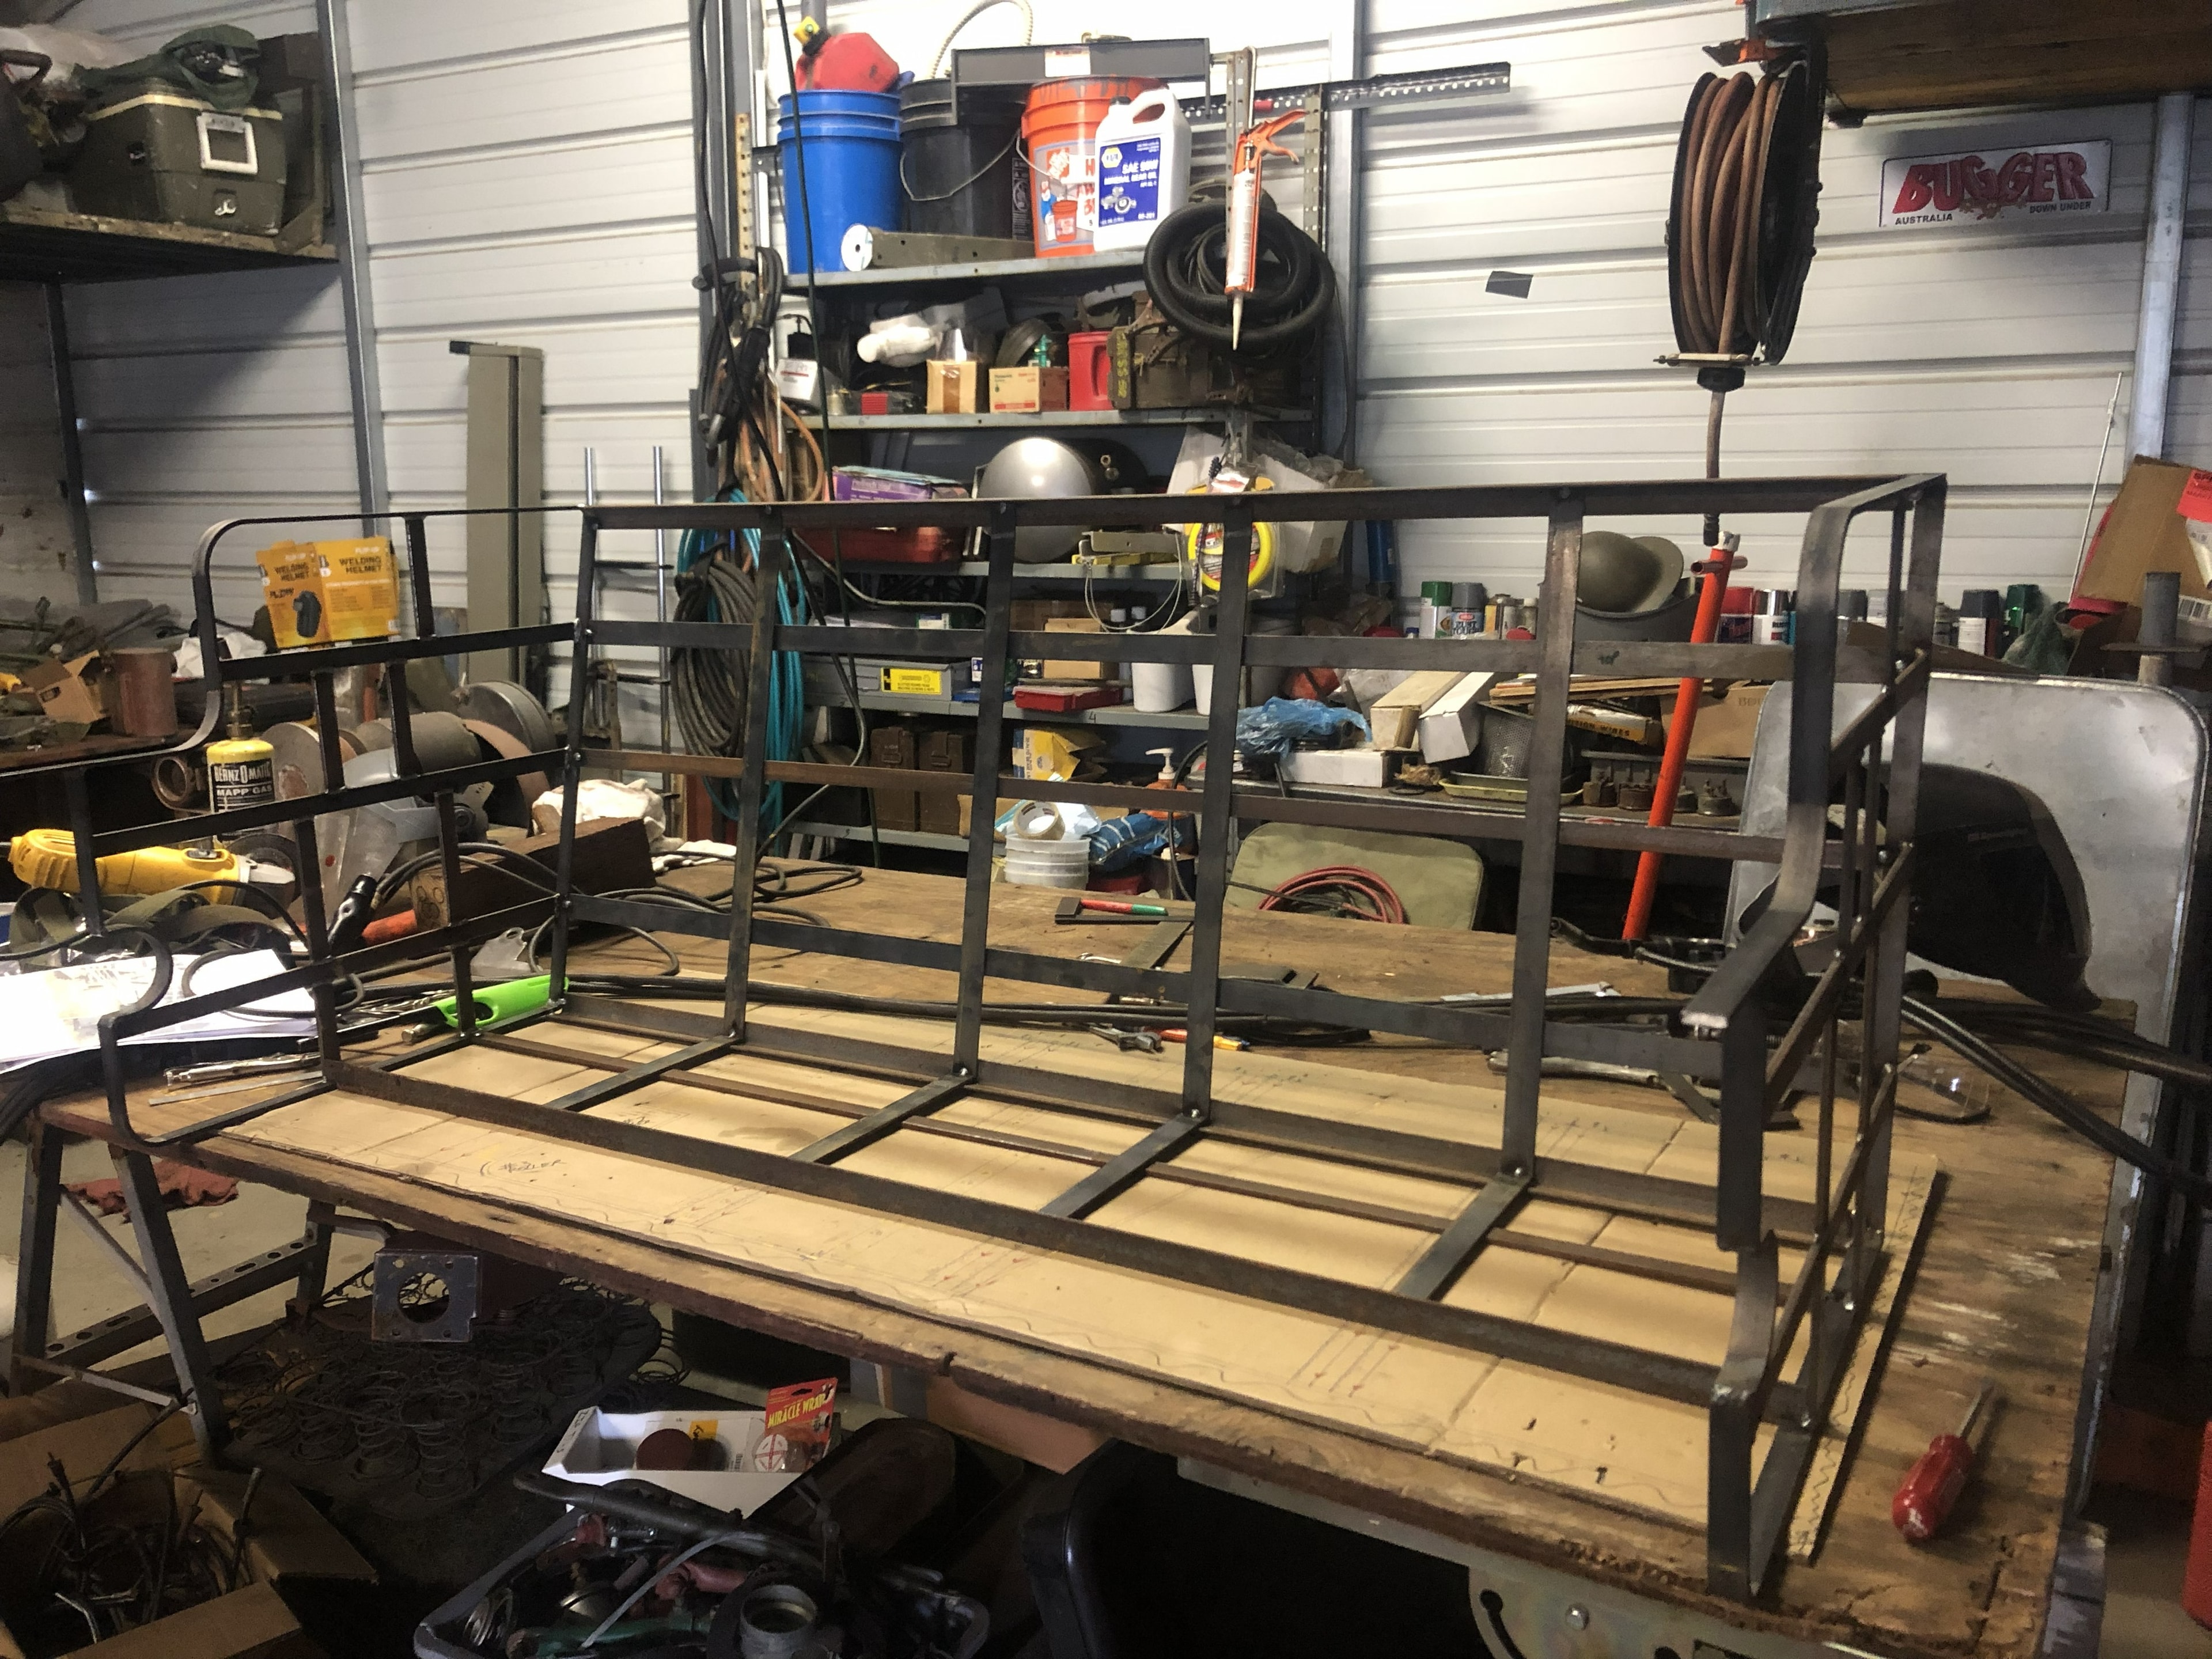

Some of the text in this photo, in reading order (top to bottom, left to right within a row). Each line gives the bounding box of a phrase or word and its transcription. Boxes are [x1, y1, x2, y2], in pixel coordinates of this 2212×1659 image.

[1122, 162, 1139, 174] SAE
[1892, 151, 2095, 214] BUGGER
[2029, 200, 2091, 214] DOWN UNDER
[1895, 213, 1953, 225] AUSTRALIA
[339, 556, 381, 566] WELDING
[274, 562, 309, 574] WELDING
[346, 565, 381, 574] HELMET
[280, 571, 309, 582] HELMET
[1088, 711, 1096, 724] 4
[217, 785, 272, 797] MAPP GAS
[767, 1401, 802, 1429] MIRACLE
[802, 1393, 827, 1415] WRAP
